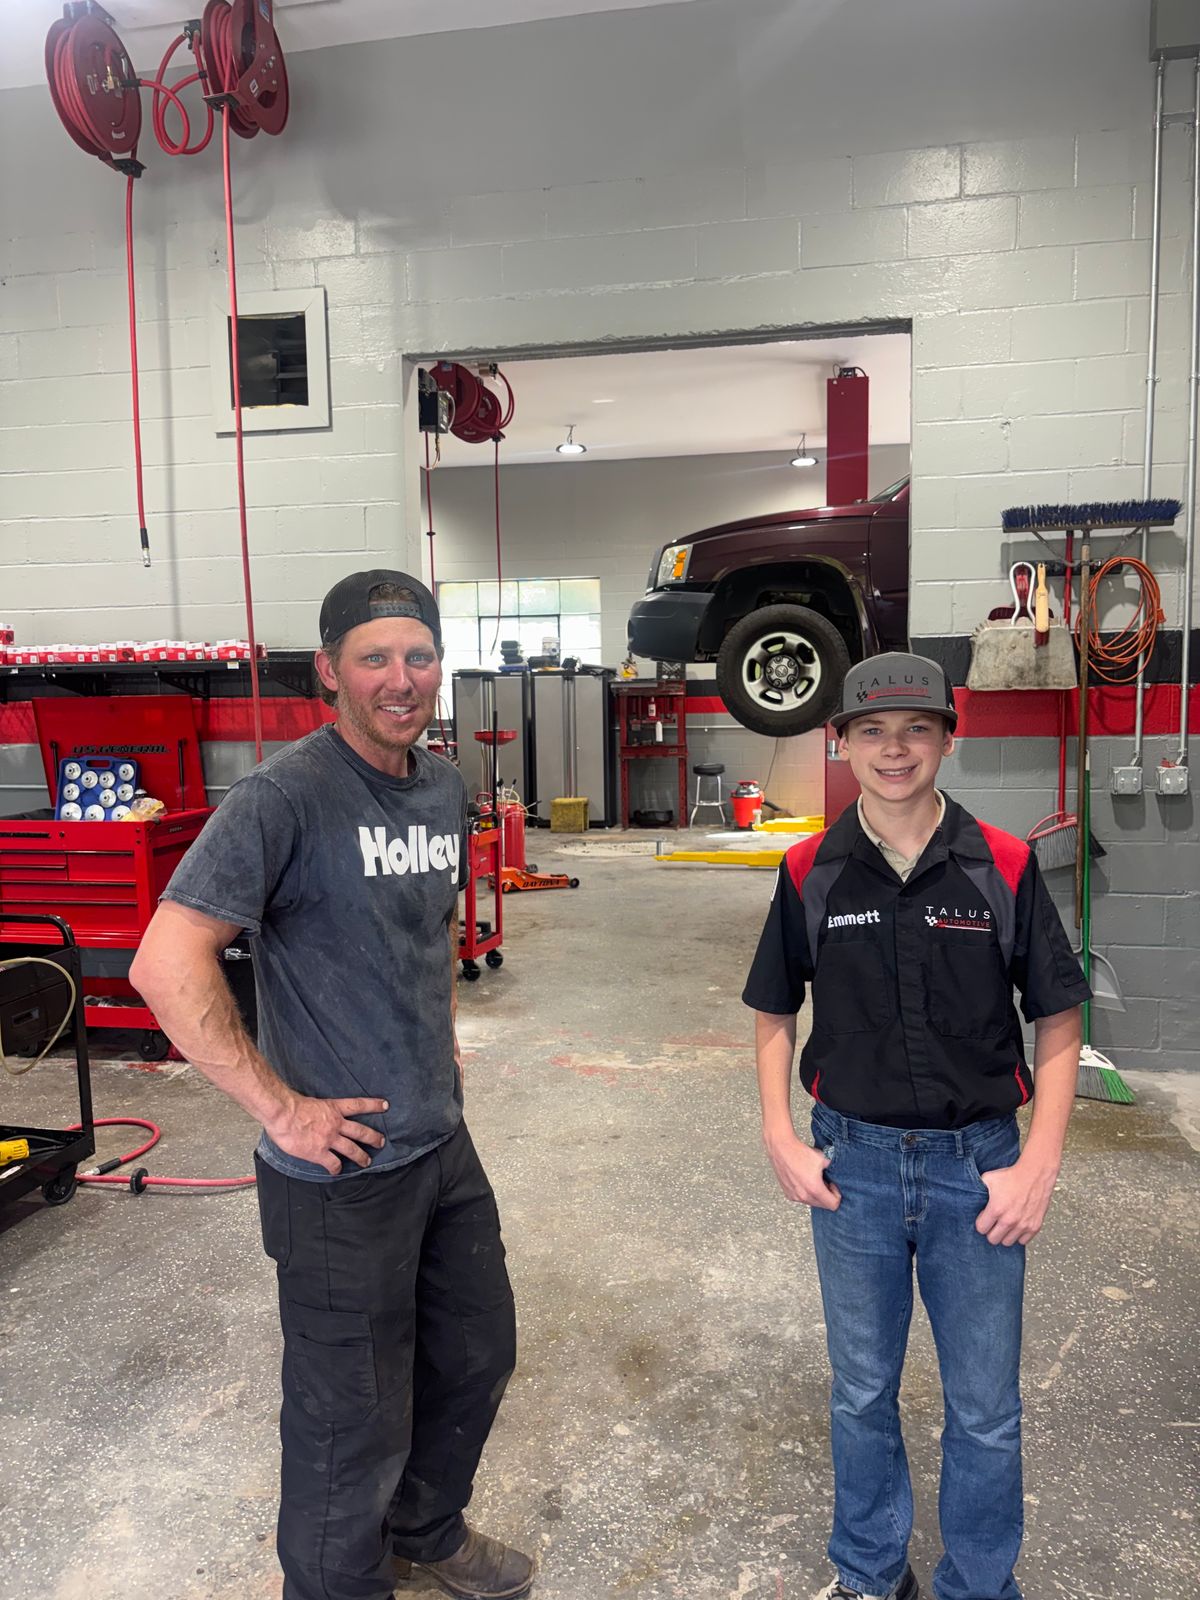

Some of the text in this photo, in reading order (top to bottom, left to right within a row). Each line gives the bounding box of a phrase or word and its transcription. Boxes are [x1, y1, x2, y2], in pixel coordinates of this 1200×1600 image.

[858, 675, 929, 690] TALUS
[358, 825, 460, 885] Holley
[827, 909, 881, 929] Emmett
[925, 905, 991, 920] TALUS
[938, 918, 990, 928] AUTOMOTIVE
